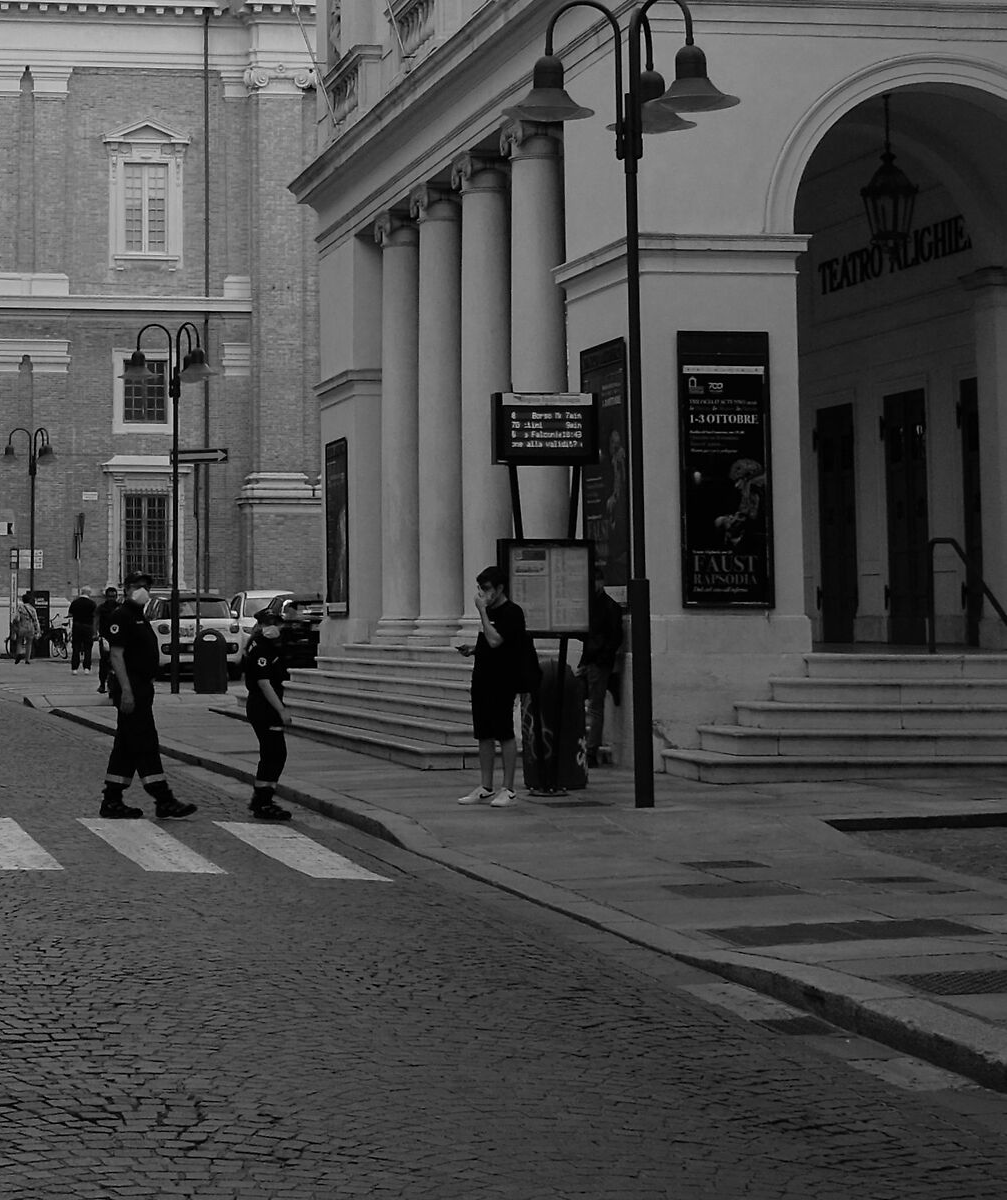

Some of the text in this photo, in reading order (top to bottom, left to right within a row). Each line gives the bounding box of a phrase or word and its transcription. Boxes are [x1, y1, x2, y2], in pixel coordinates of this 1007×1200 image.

[818, 214, 972, 295] TEATRO ALIGHIE
[690, 414, 759, 424] 1-3 OTTOBRE
[694, 555, 758, 572] FAUST
[693, 573, 758, 585] RAPSODIA
